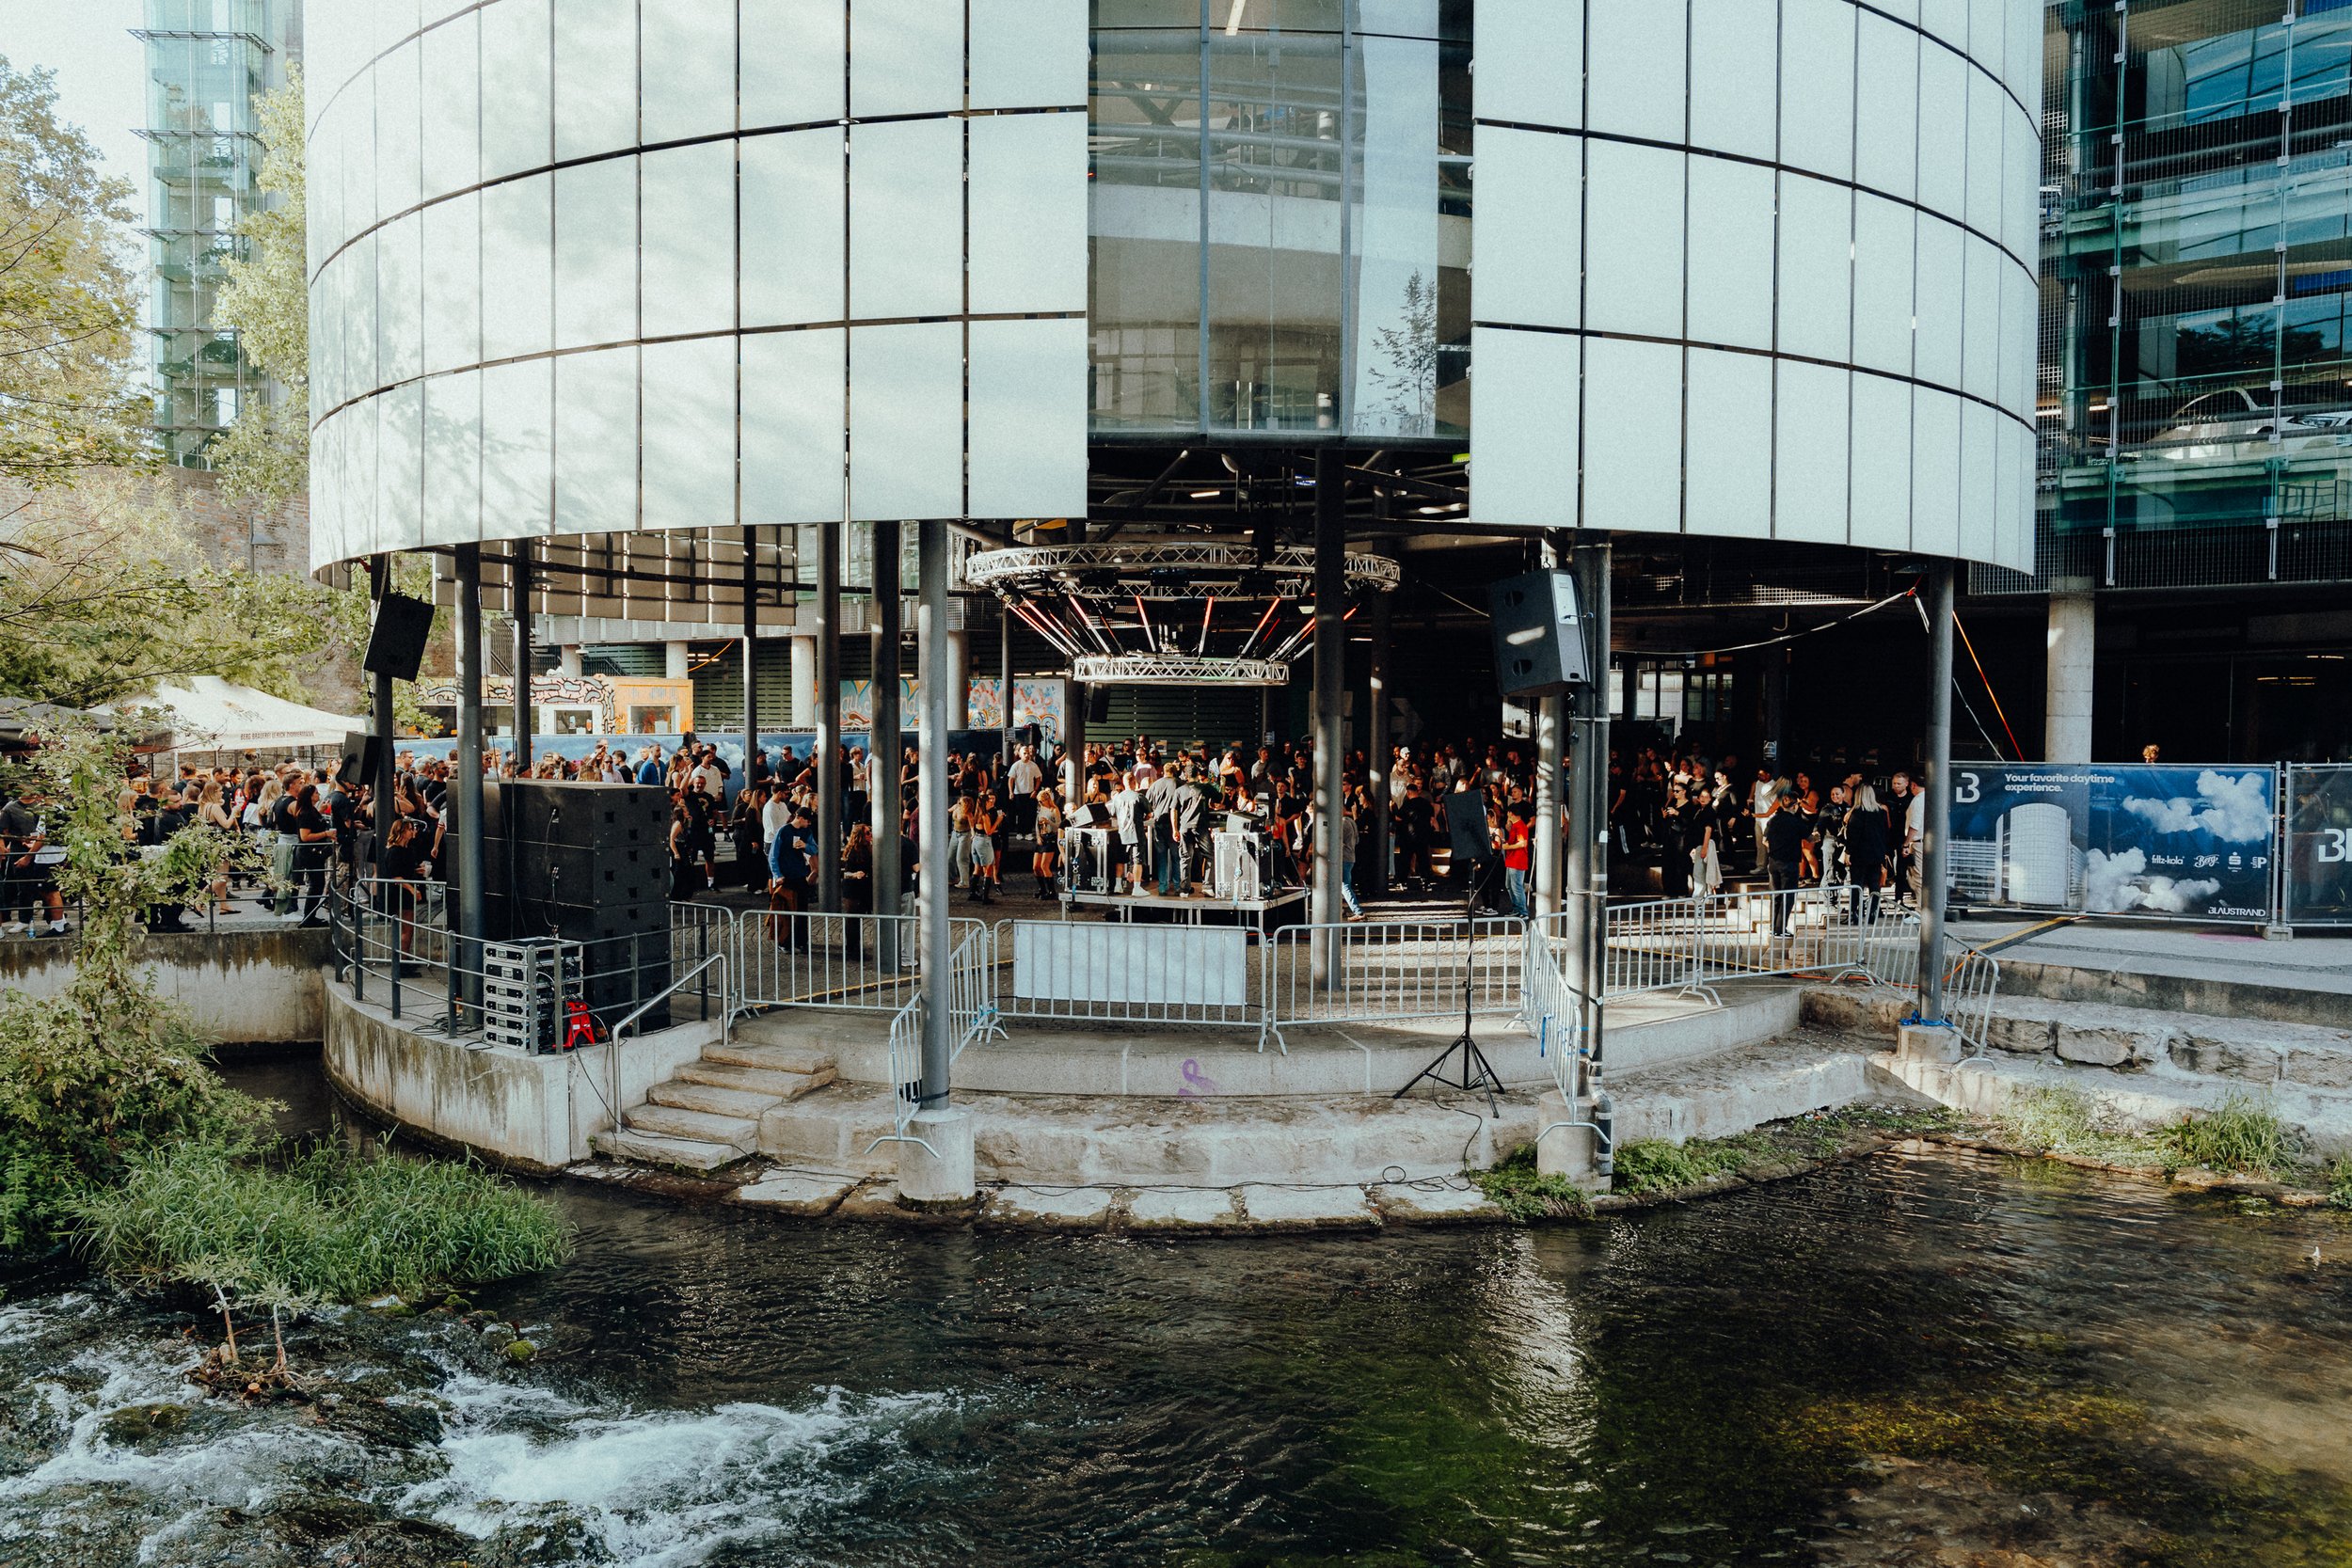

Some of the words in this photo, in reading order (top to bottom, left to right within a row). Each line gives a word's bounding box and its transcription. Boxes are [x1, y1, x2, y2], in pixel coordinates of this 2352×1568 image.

[2005, 773, 2029, 783] Your
[2029, 773, 2069, 783] favorite
[2070, 773, 2115, 784] daytime
[2005, 783, 2063, 793] experience.
[2194, 854, 2220, 867] Berg
[2208, 906, 2266, 917] BLAUSTRAND
